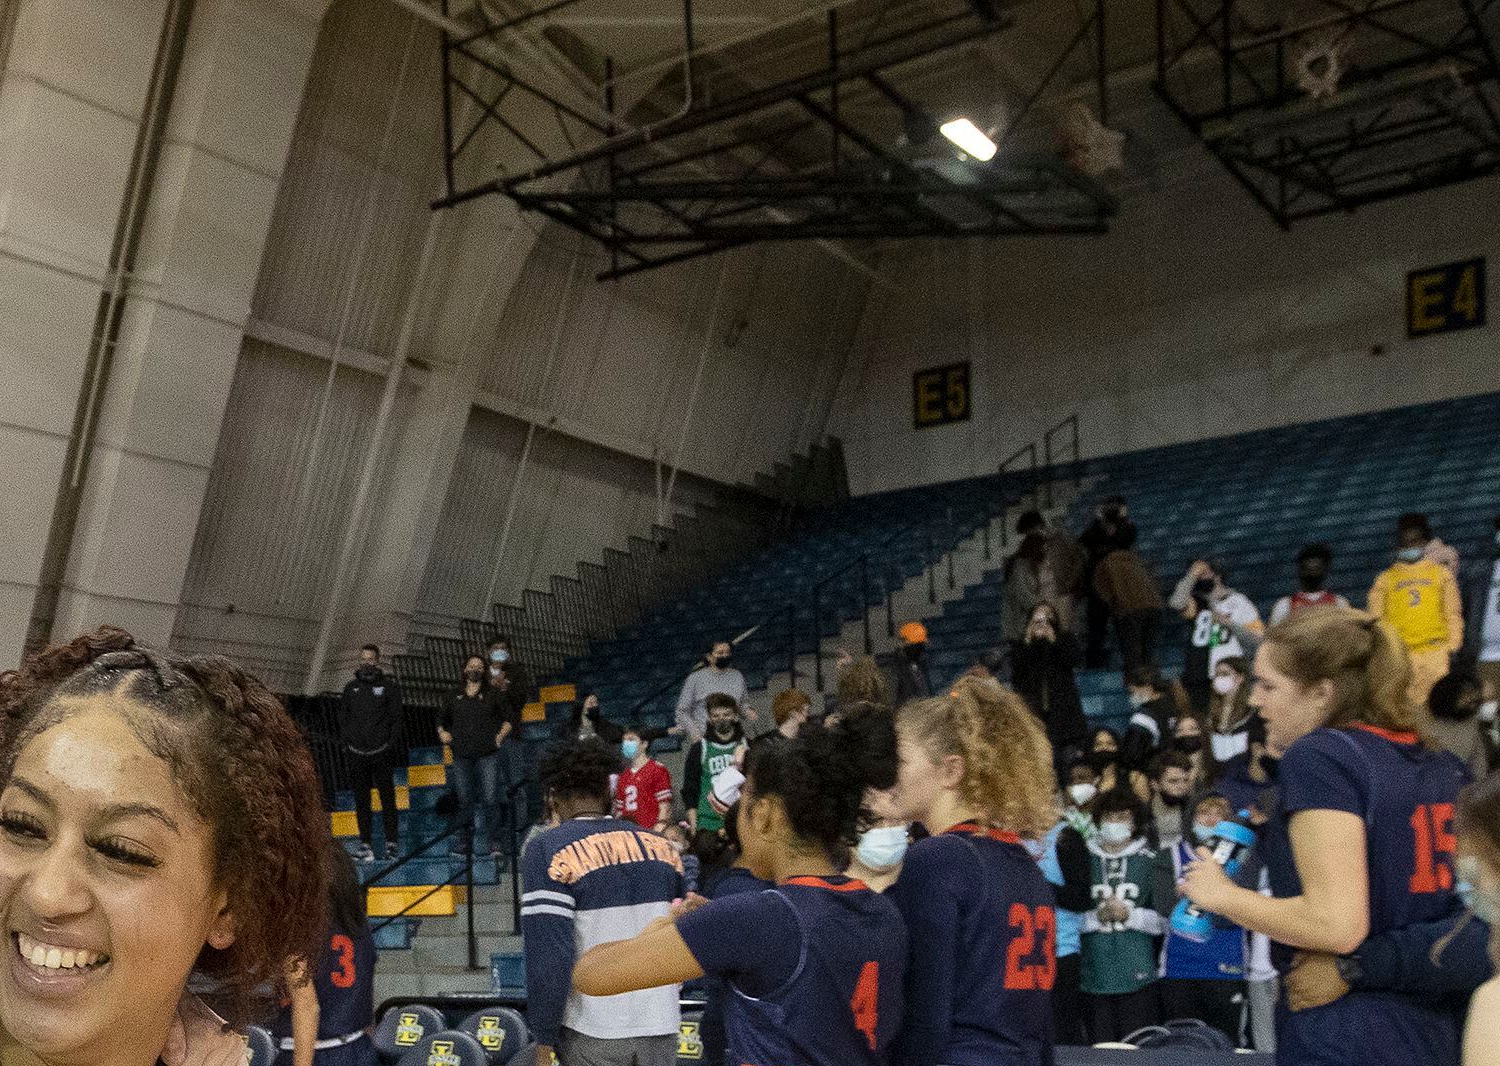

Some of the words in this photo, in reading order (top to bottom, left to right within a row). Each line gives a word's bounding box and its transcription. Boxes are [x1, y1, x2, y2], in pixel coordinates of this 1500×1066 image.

[1411, 267, 1476, 329] E4
[920, 369, 966, 421] E5
[1409, 803, 1458, 893] 15
[330, 934, 356, 988] 3
[1003, 902, 1057, 991] 23
